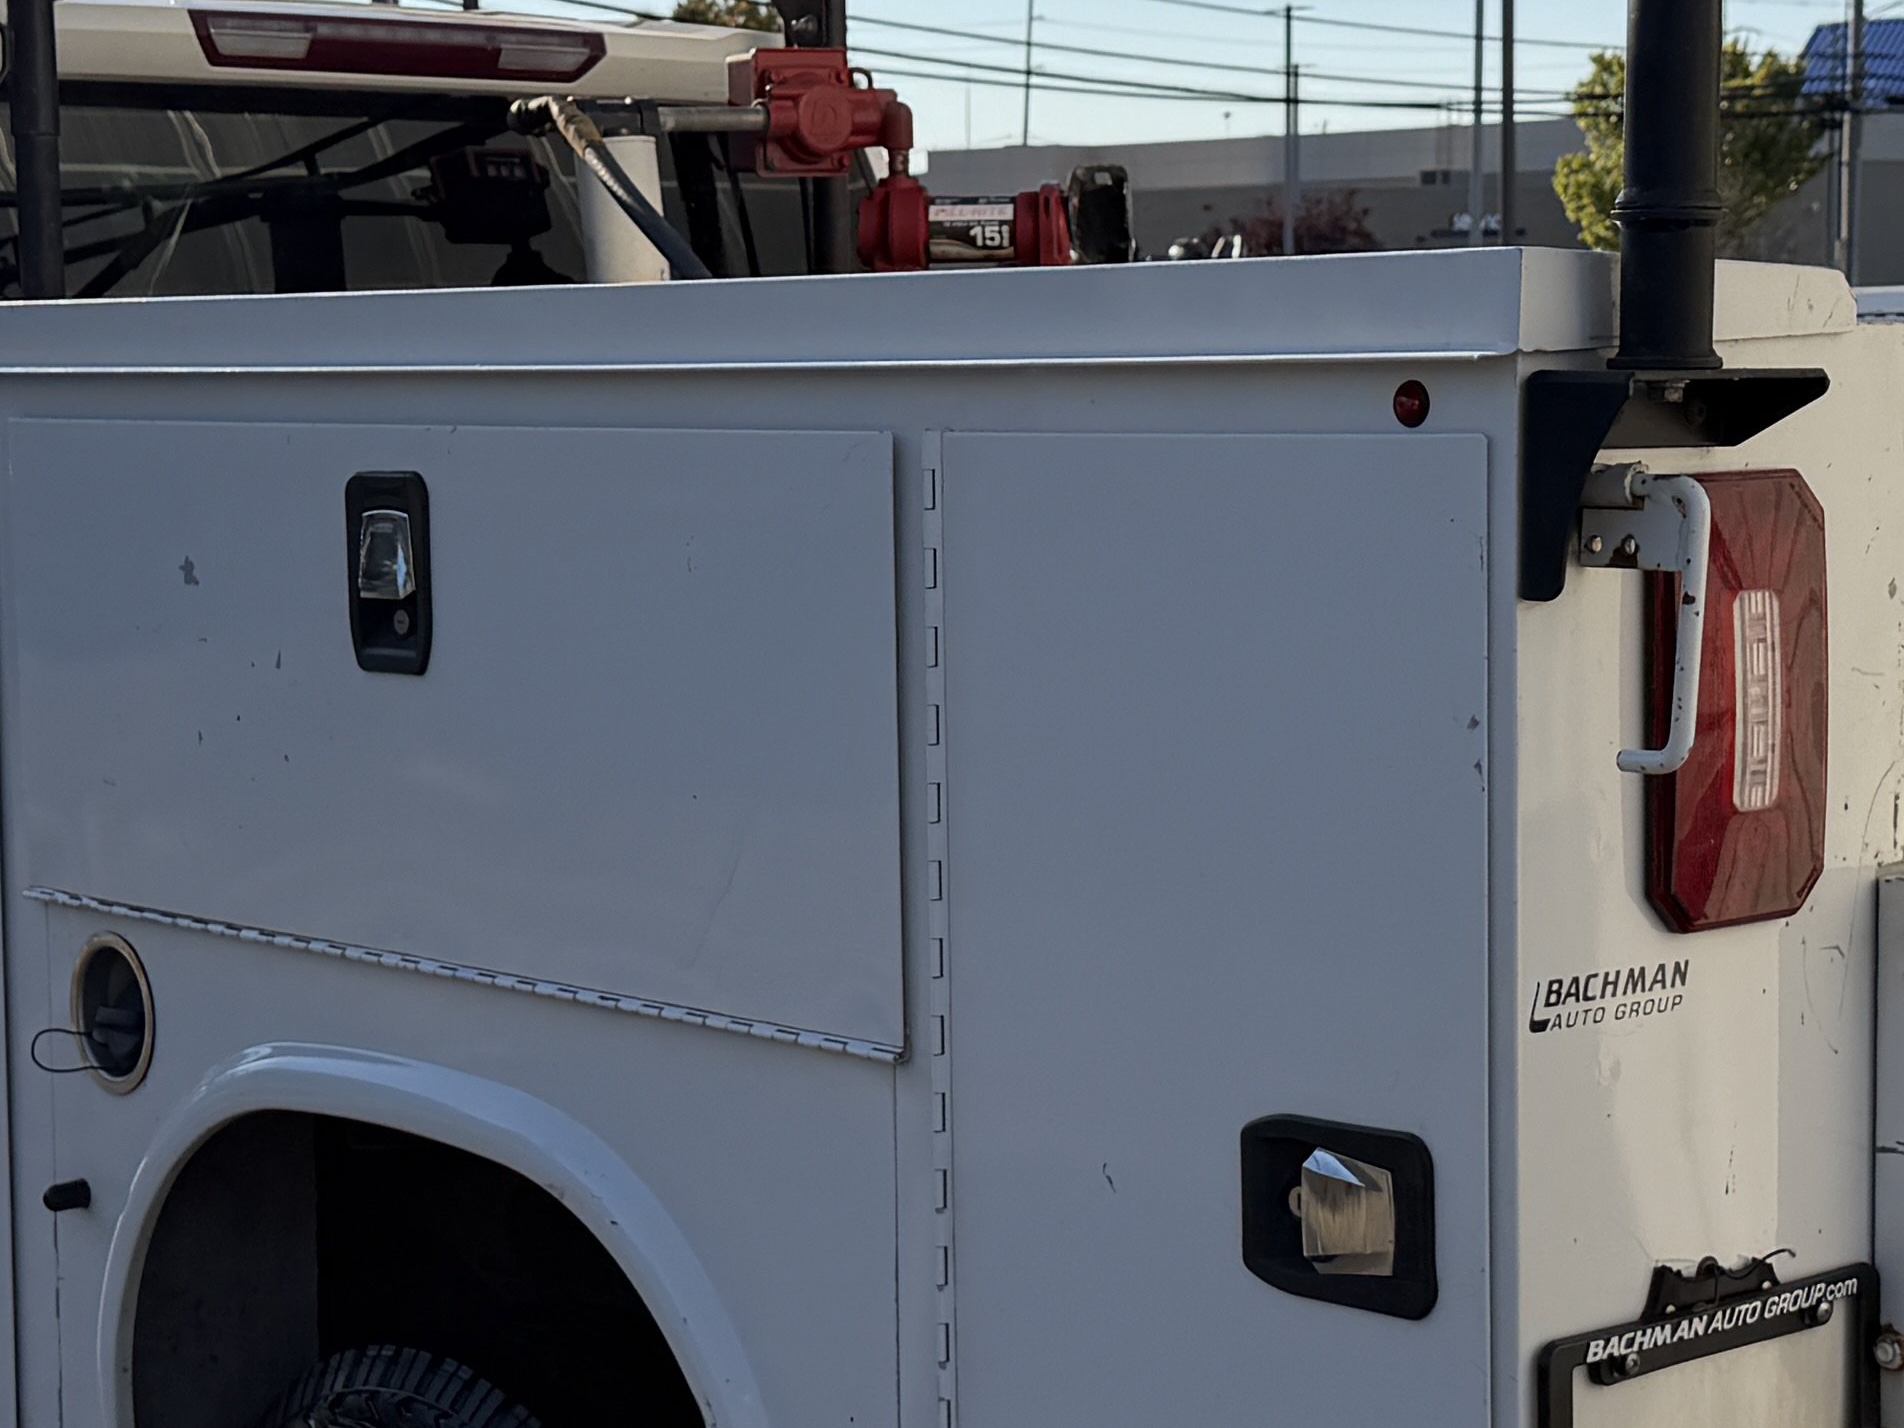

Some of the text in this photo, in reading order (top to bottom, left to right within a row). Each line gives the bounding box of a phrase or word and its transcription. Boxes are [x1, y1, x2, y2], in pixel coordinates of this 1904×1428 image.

[1544, 959, 1689, 1008] BACHMAN
[1550, 994, 1684, 1031] AUTO GROUP
[1586, 1314, 1708, 1363] BACHMAN
[1707, 1301, 1762, 1334] AUTO
